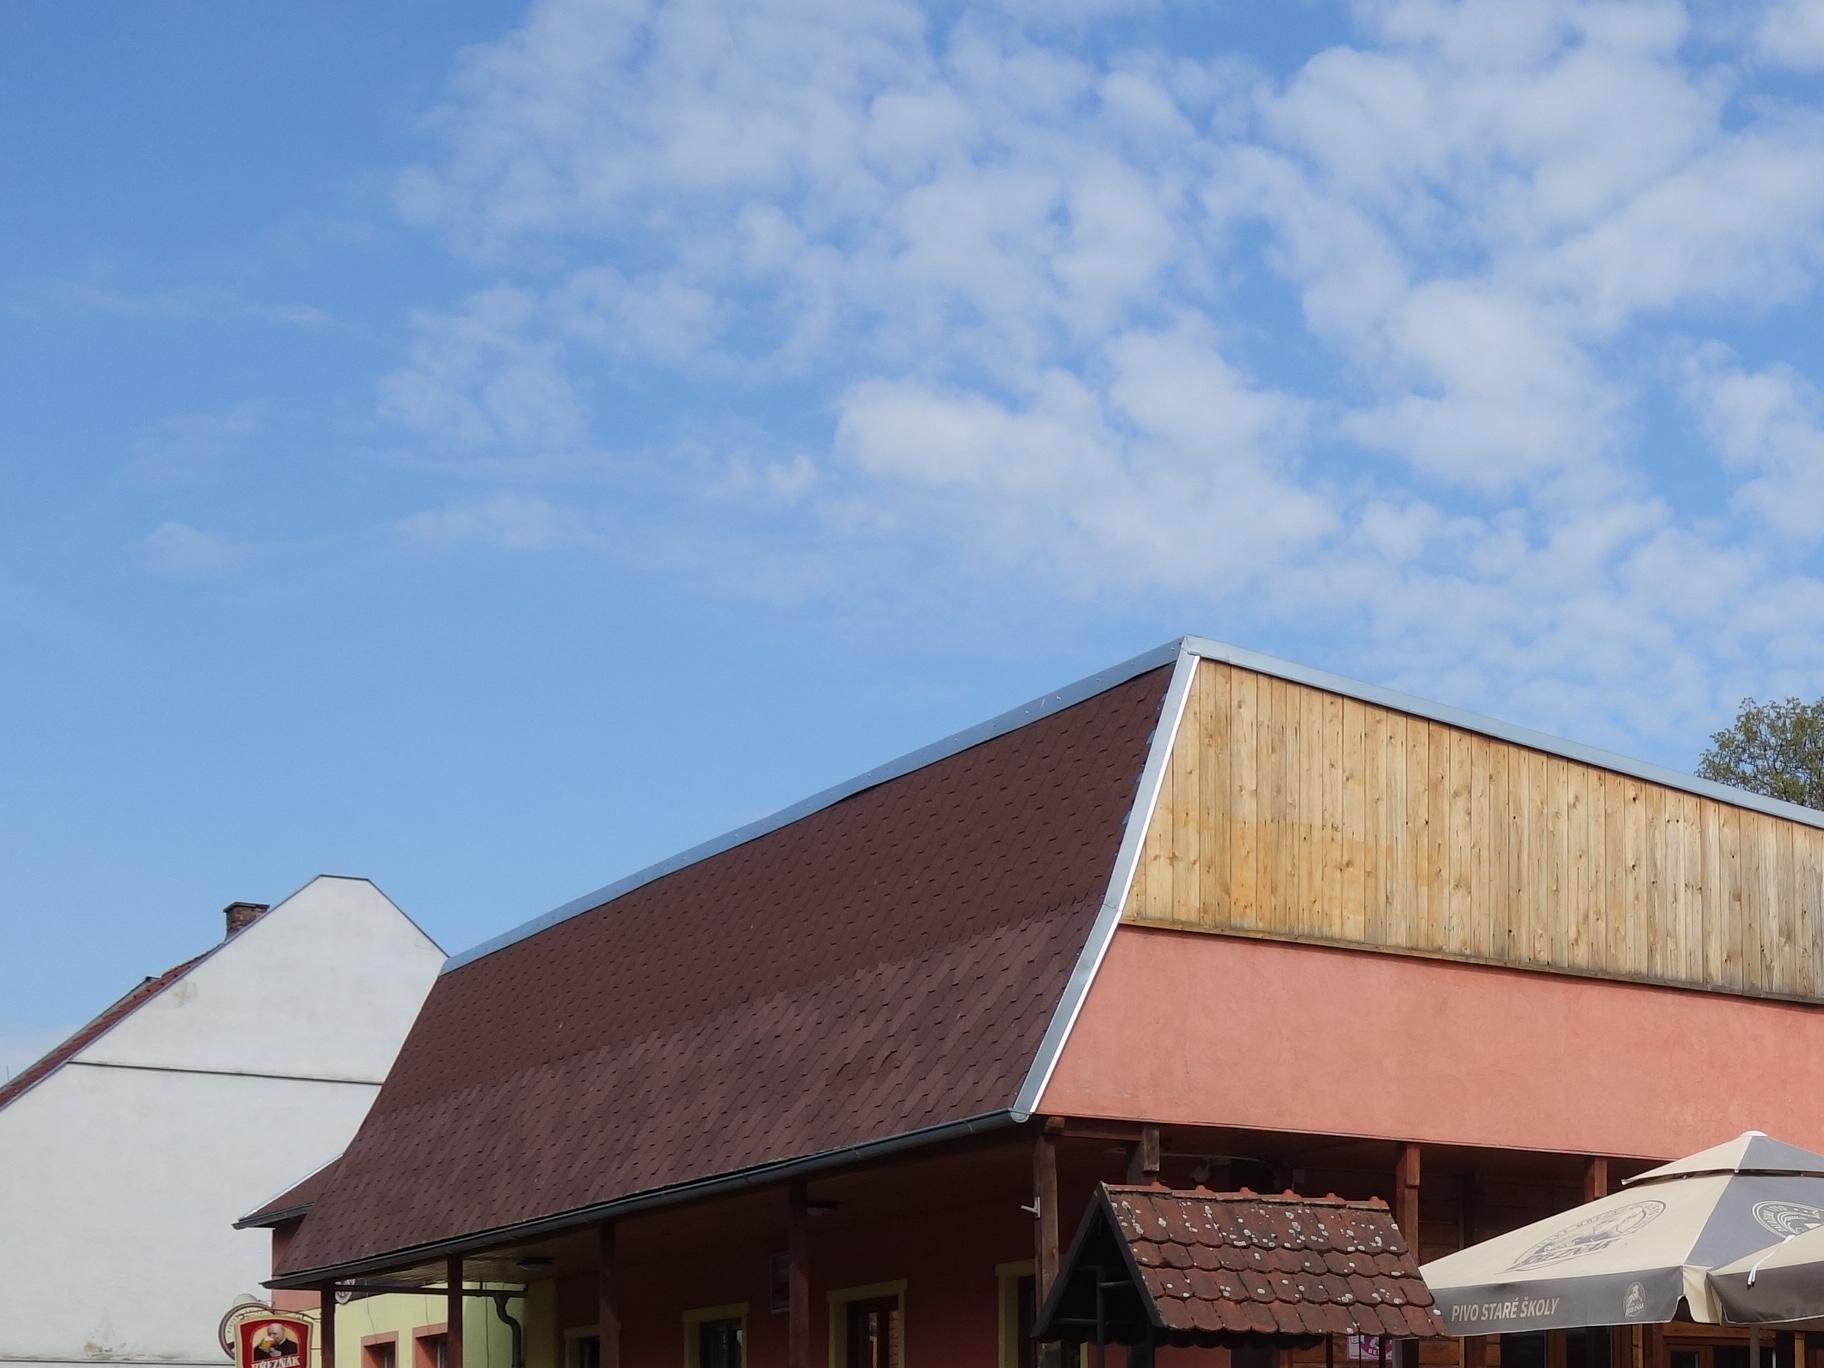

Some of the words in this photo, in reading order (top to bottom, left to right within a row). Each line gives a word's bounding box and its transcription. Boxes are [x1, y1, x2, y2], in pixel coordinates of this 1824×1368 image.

[1451, 1303, 1479, 1322] PIVO
[1480, 1297, 1518, 1321] STARÉ
[1520, 1293, 1560, 1317] ŠKOLY
